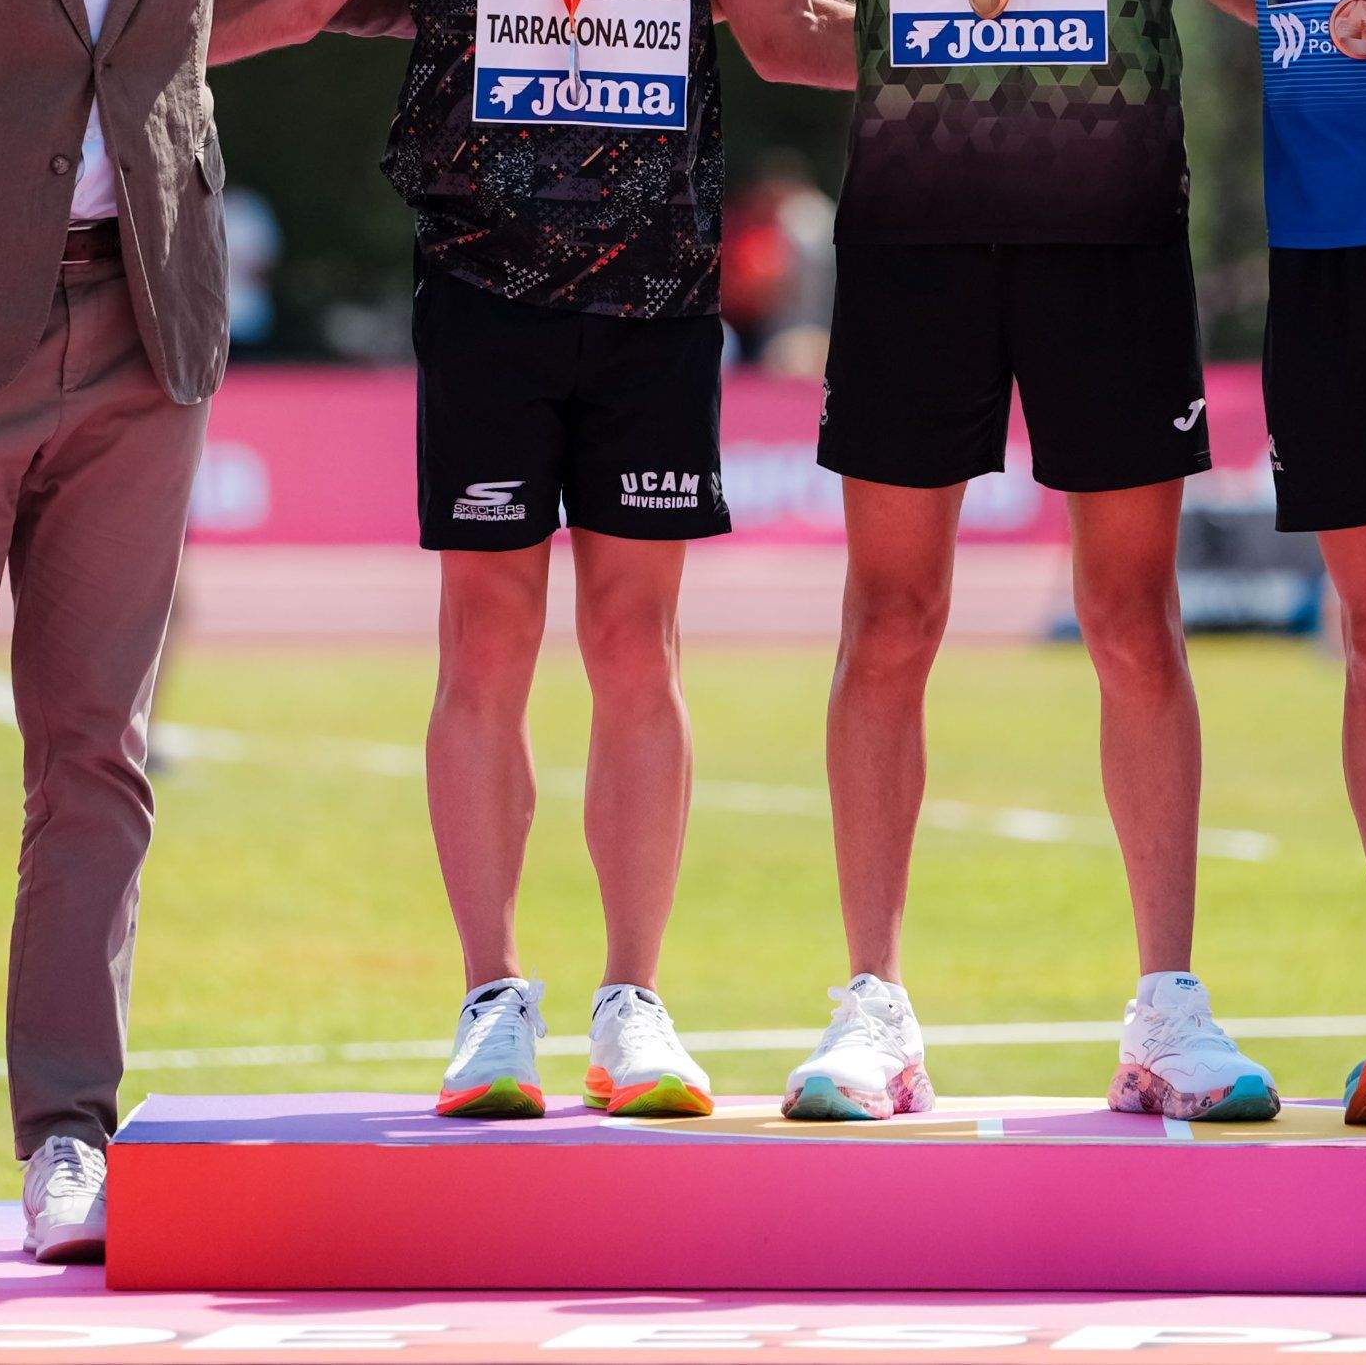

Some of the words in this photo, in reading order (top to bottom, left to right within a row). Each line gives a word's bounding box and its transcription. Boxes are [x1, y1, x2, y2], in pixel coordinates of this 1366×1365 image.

[633, 19, 681, 51] 2025
[621, 472, 700, 495] UCAM
[453, 503, 526, 515] SKECHERS
[621, 493, 699, 509] UNIVERSIDAD
[452, 512, 526, 522] PERFORMANCE
